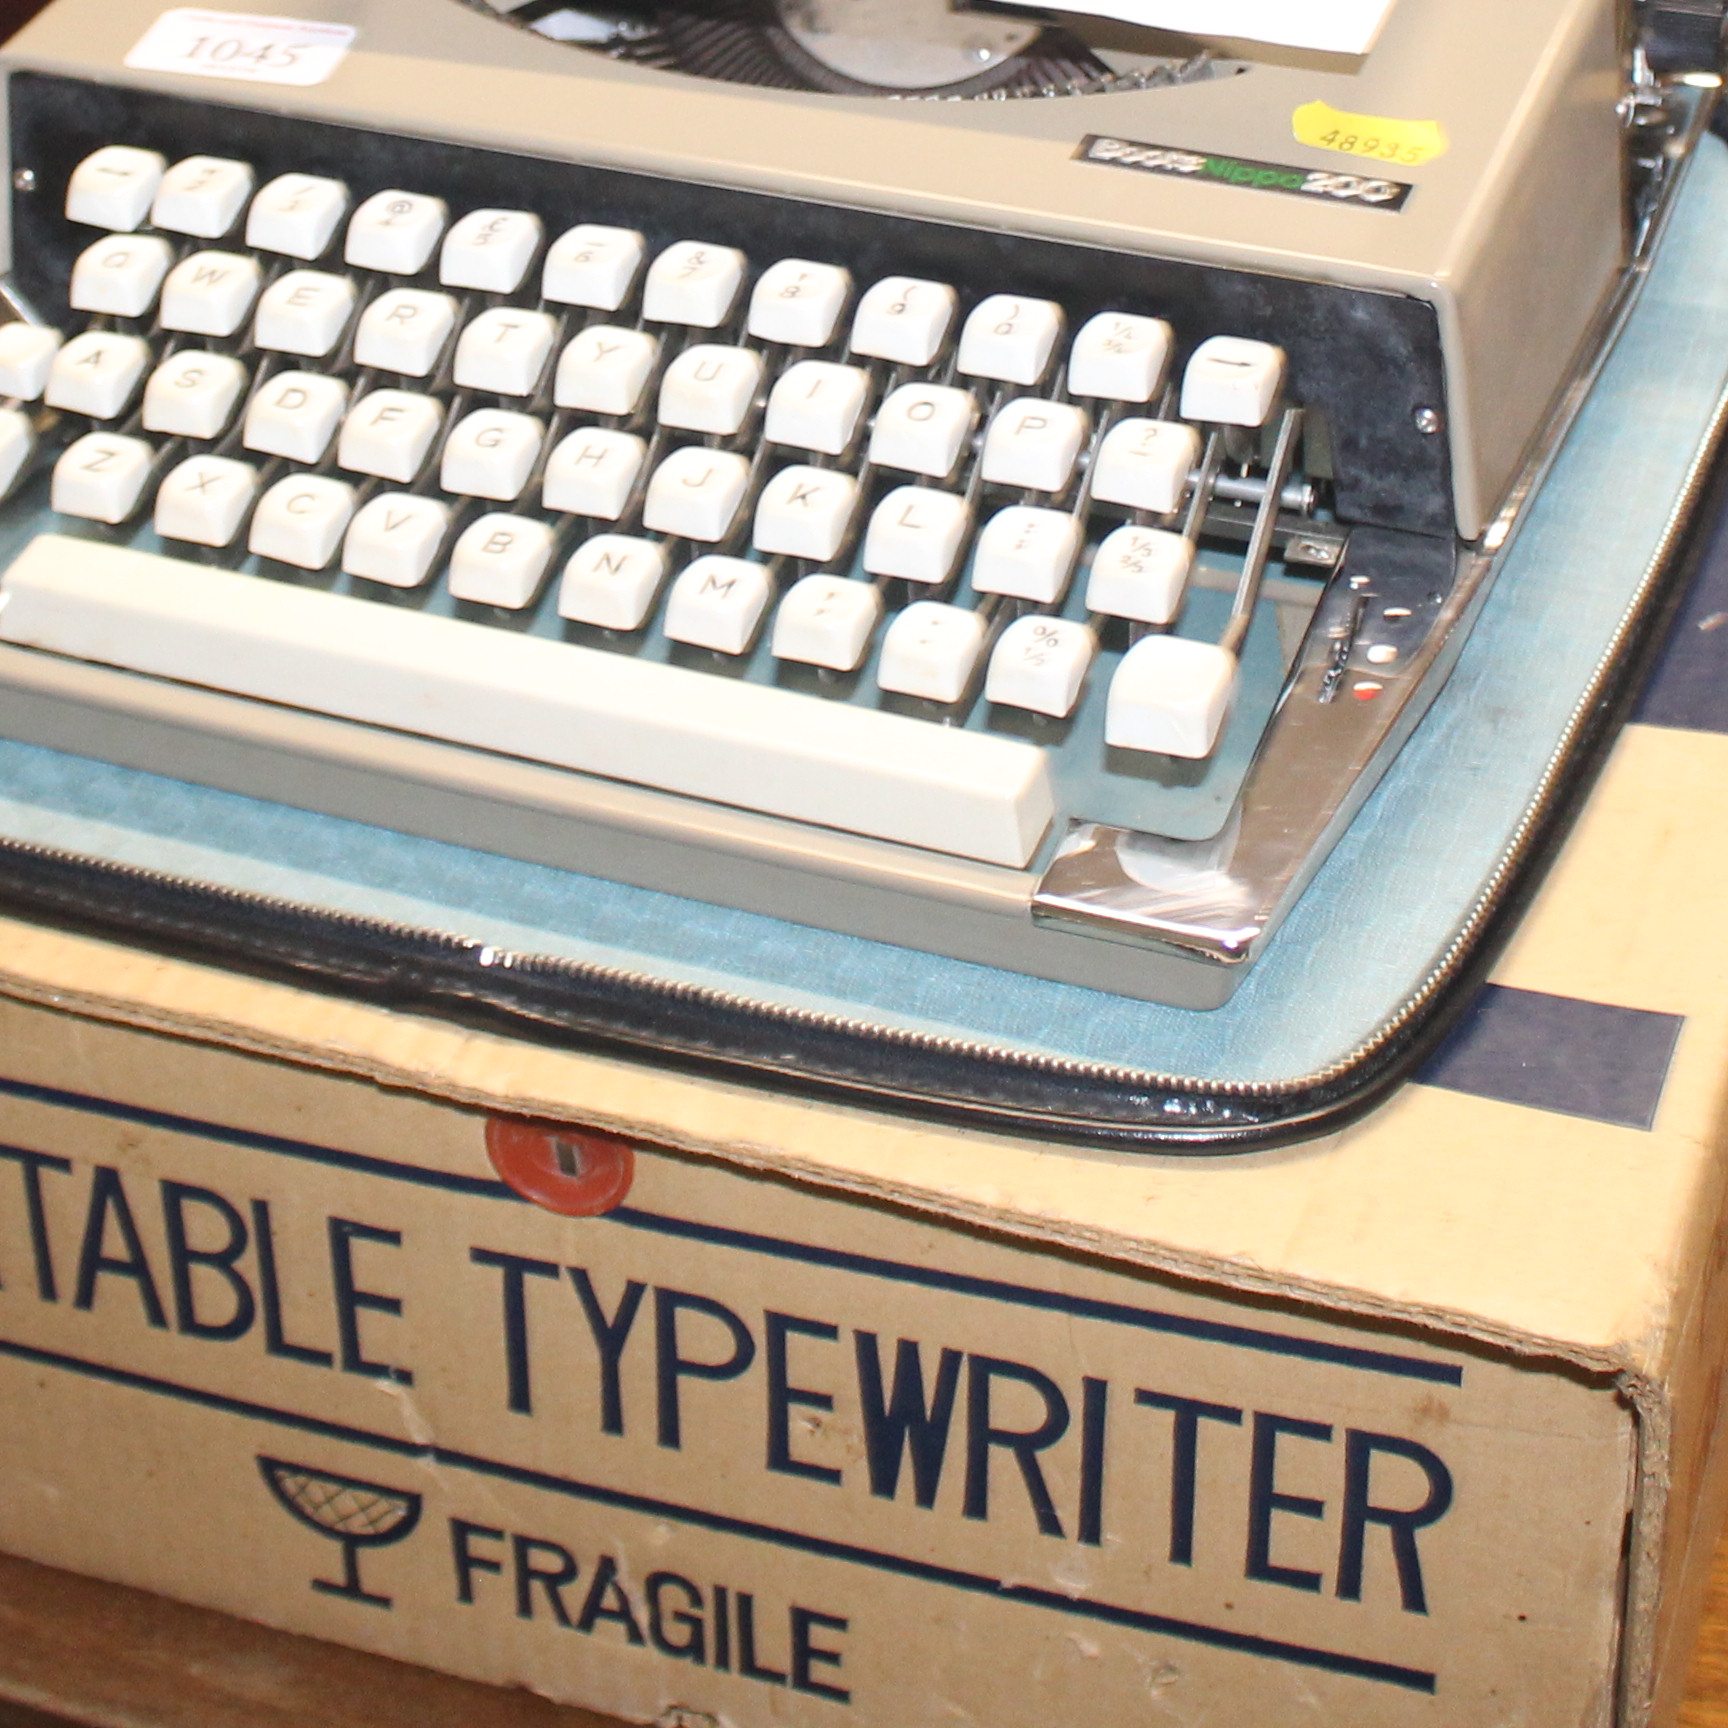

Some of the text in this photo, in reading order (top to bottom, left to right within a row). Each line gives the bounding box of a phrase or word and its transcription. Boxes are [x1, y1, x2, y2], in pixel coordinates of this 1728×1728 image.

[180, 35, 315, 68] 1045
[1319, 129, 1426, 163] 48935
[190, 265, 230, 286] W
[285, 286, 321, 307] E
[384, 303, 419, 325] R
[494, 324, 521, 344] T
[592, 341, 621, 363] Y
[693, 360, 723, 382] U
[1014, 415, 1048, 436] P
[76, 348, 105, 369] A
[173, 368, 205, 388] S
[274, 387, 308, 410] D
[369, 406, 405, 426] F
[475, 427, 506, 448] G
[574, 444, 610, 468] H
[681, 467, 715, 488] J
[785, 482, 823, 508] K
[896, 503, 923, 529] L
[79, 448, 118, 473] Z
[183, 471, 229, 495] X
[286, 493, 317, 515] C
[383, 509, 414, 532] V
[481, 531, 513, 554] B
[592, 551, 636, 576] N
[698, 573, 738, 599] M
[469, 1246, 1454, 1616] TYPEWRITER
[448, 1516, 852, 1705] FRAGILE
